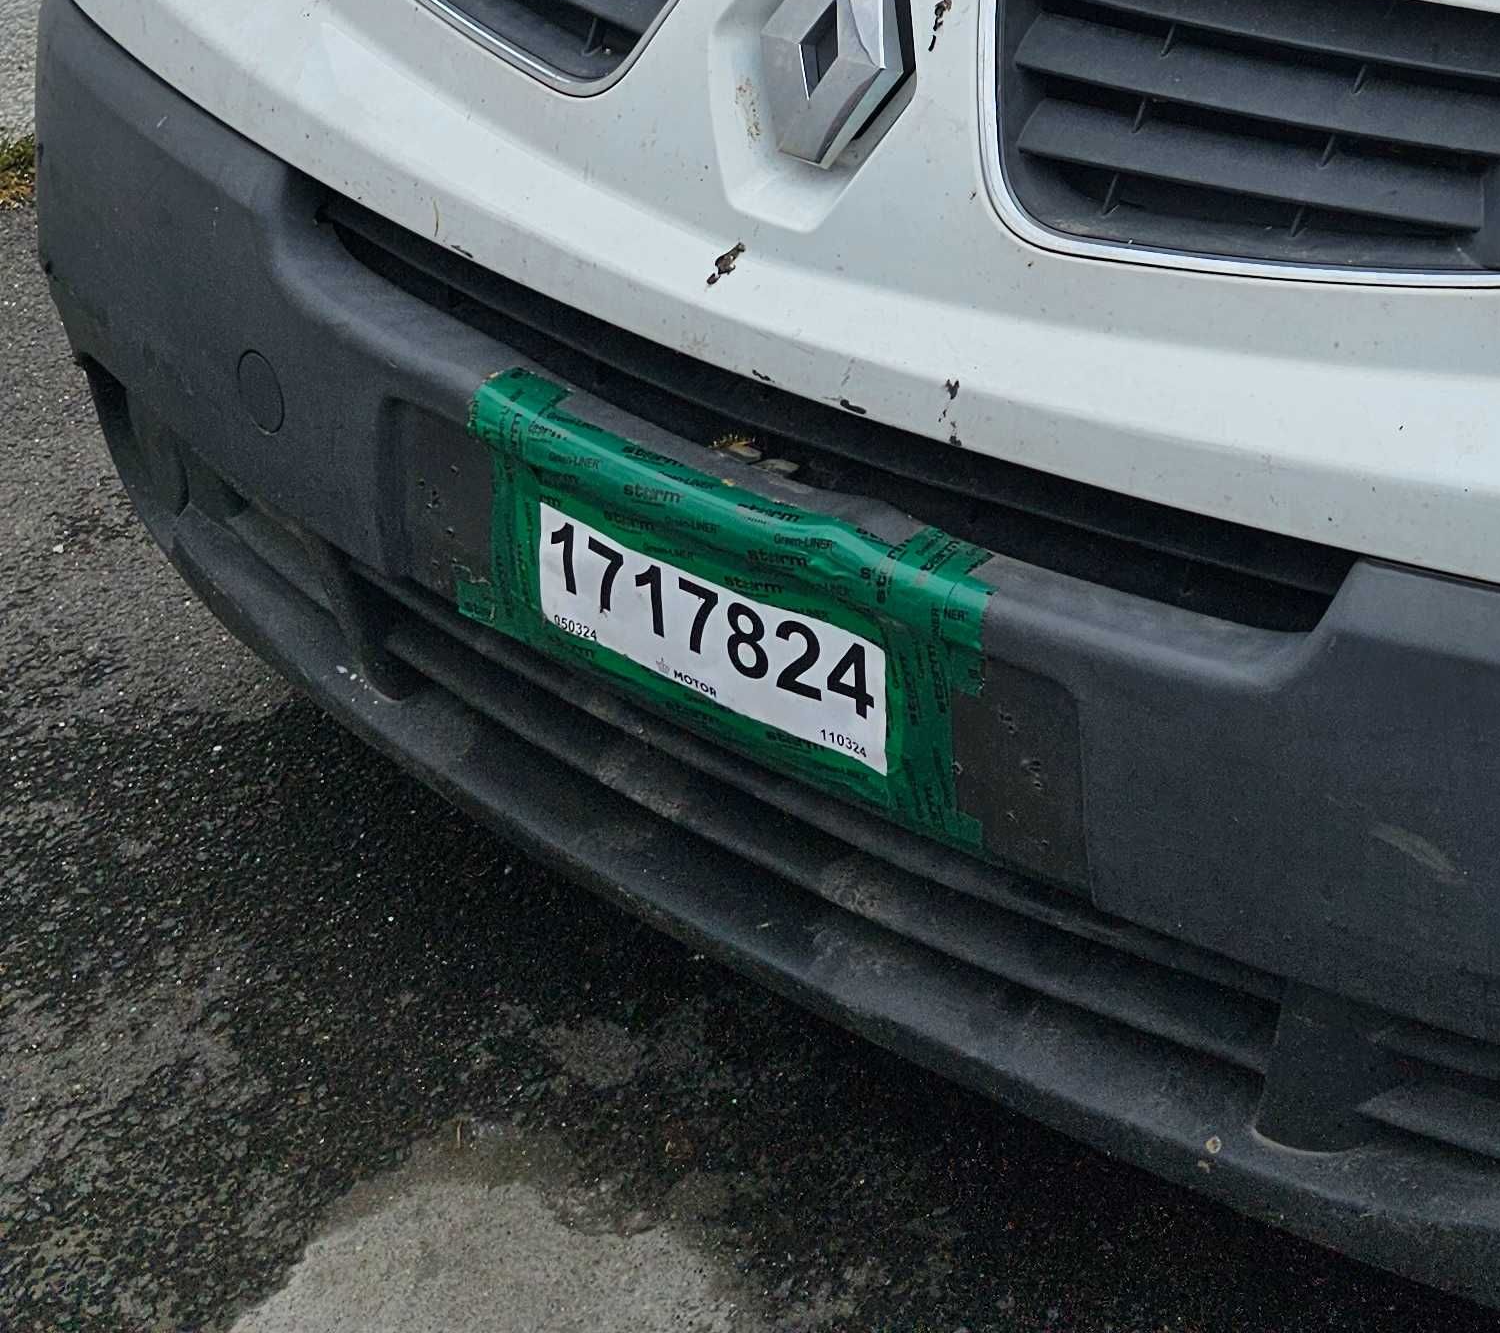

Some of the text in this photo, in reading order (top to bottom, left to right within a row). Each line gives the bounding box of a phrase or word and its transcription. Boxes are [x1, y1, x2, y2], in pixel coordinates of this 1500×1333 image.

[550, 522, 875, 720] 1717824
[553, 614, 597, 643] 050324
[673, 669, 718, 698] MOTOR
[820, 728, 867, 758] 110324
